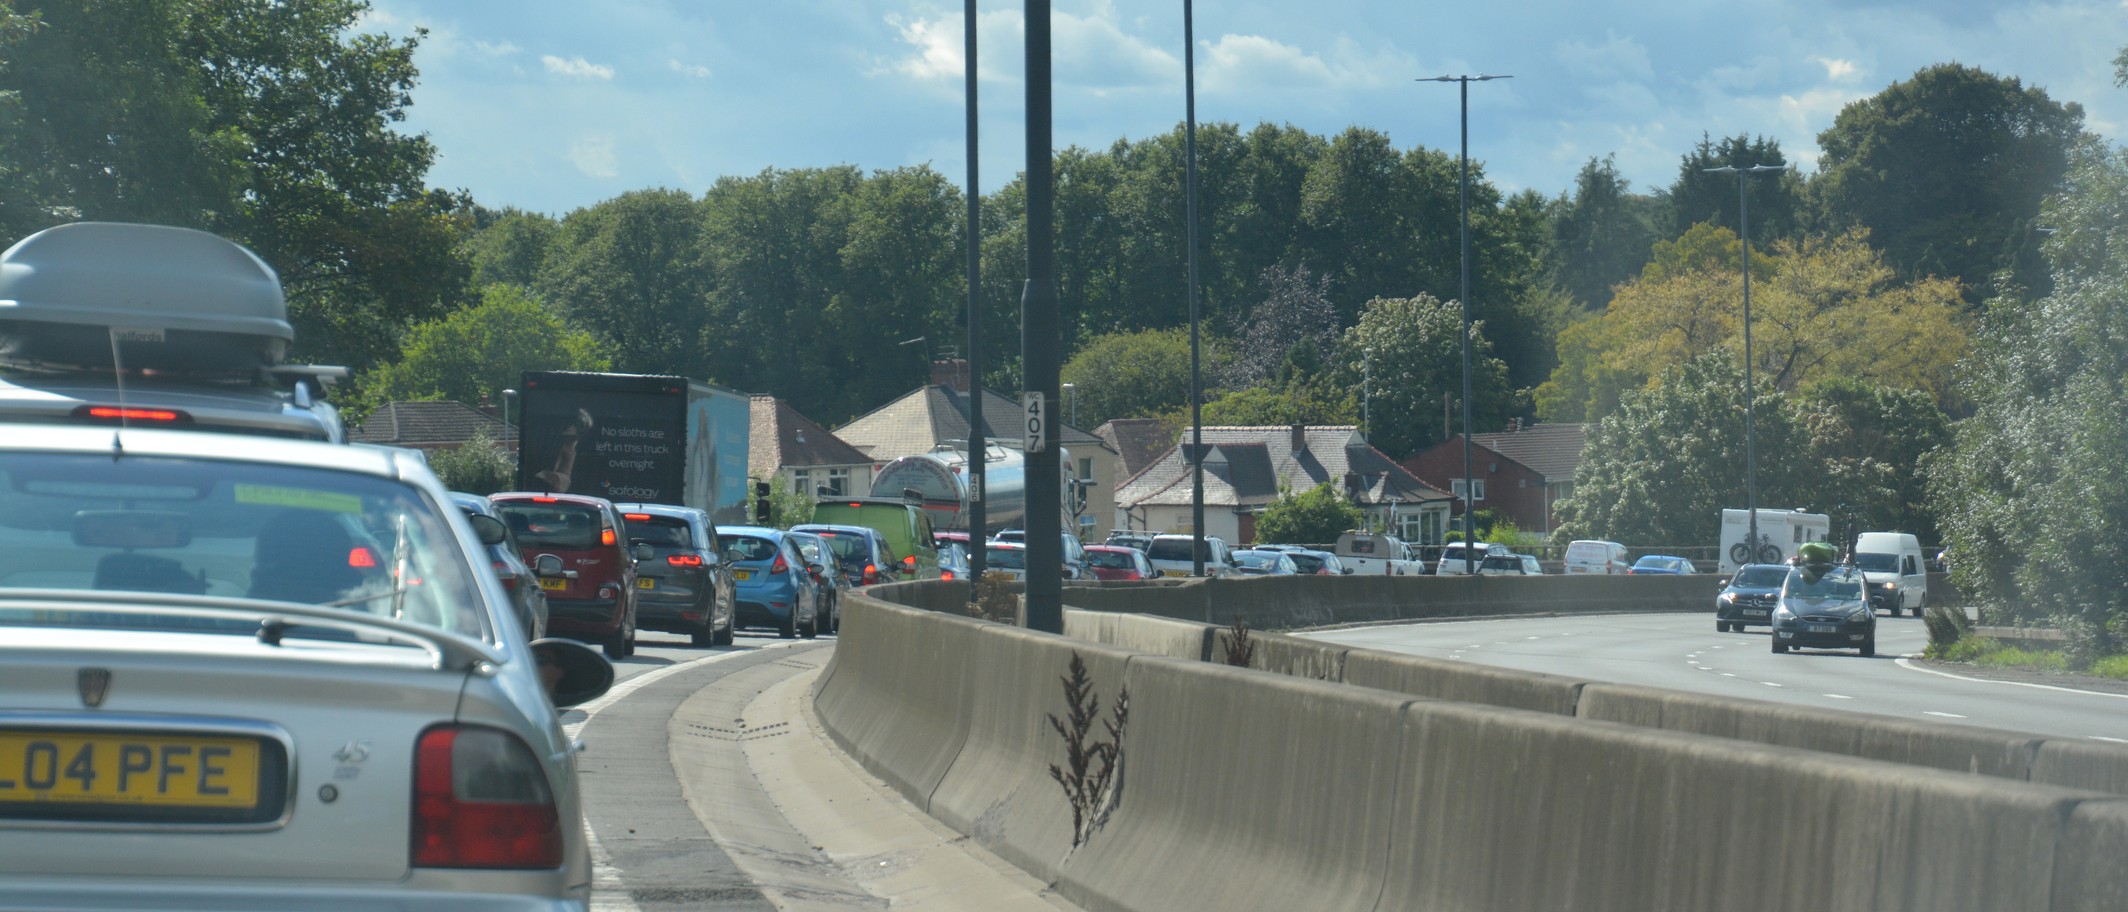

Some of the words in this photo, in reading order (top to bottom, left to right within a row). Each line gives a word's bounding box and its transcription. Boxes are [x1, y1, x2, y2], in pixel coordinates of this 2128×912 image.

[601, 426, 617, 437] No
[618, 426, 647, 438] sloths
[648, 429, 665, 439] are
[1027, 401, 1041, 451] 407
[595, 441, 612, 452] left
[614, 442, 623, 452] in
[624, 442, 642, 453] this
[643, 443, 669, 455] truck
[608, 485, 660, 499] sofology
[970, 477, 978, 501] 406
[117, 742, 233, 796] PFE
